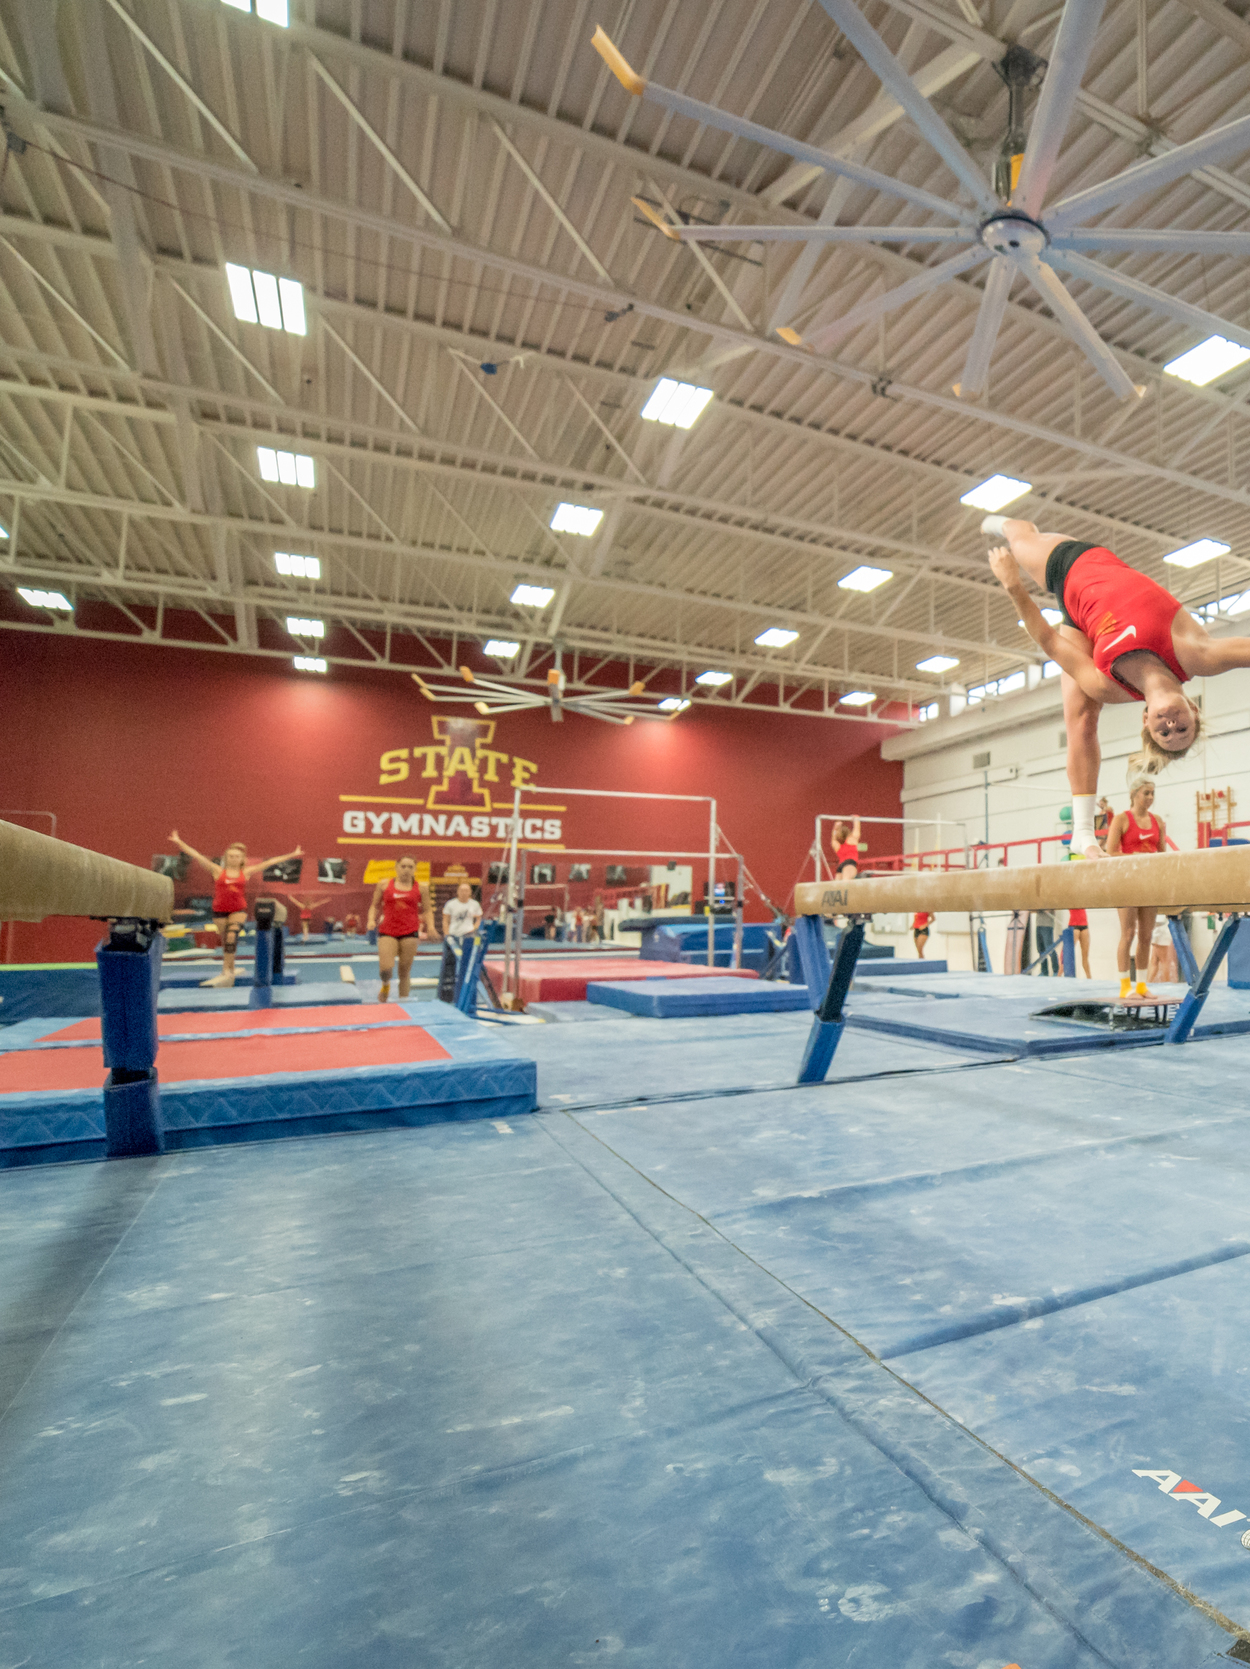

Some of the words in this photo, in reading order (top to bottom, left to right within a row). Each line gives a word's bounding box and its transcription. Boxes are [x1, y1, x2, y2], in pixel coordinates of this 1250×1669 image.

[379, 746, 538, 793] STATE
[343, 811, 562, 840] GYMNASTICS
[1131, 1469, 1247, 1528] AAI
